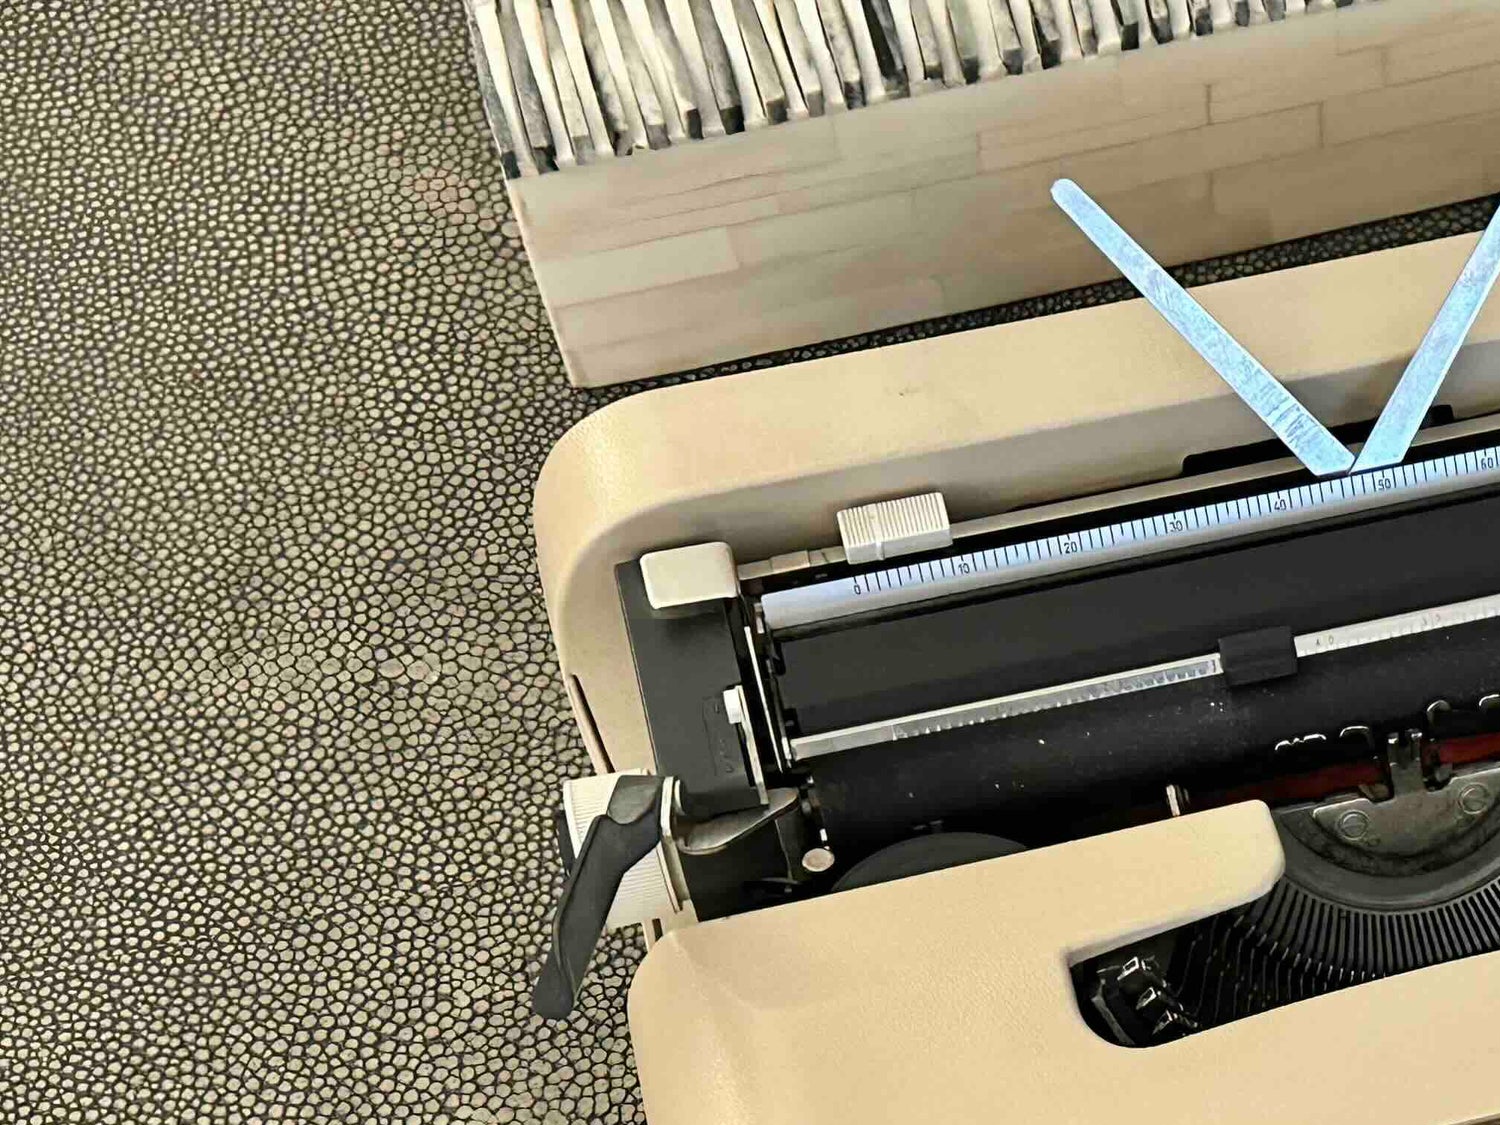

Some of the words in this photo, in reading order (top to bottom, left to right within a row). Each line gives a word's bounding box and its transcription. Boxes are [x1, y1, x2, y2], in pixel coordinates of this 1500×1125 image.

[854, 585, 861, 595] 0
[958, 563, 970, 574] 10
[1064, 541, 1077, 553] 20
[1169, 520, 1183, 532] 30
[1274, 499, 1287, 510] 40
[1378, 478, 1391, 490] 50
[1481, 457, 1494, 469] 60
